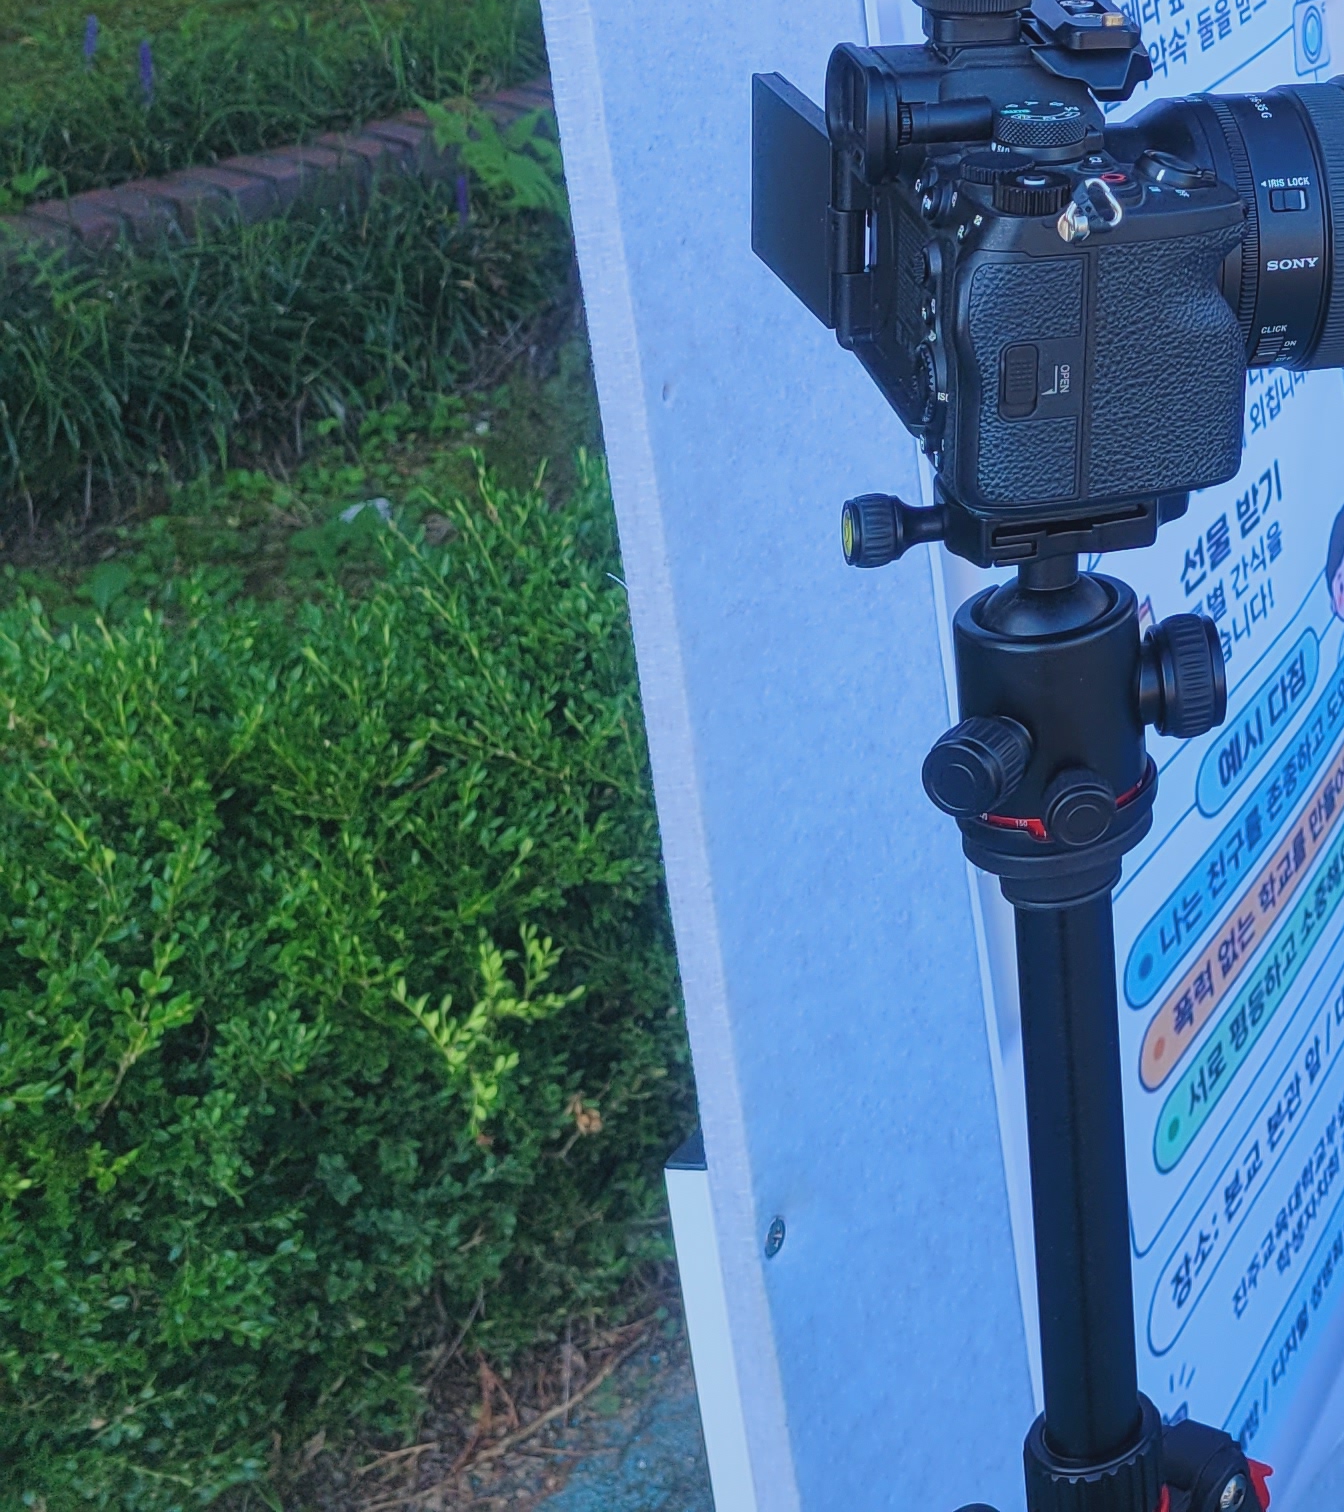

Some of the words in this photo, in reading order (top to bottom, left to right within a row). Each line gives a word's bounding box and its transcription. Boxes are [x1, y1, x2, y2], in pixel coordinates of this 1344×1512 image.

[1268, 178, 1284, 188] IRIS
[1287, 176, 1310, 187] LOCK
[1266, 257, 1319, 271] SONY
[1261, 324, 1287, 334] CLICK
[1060, 364, 1070, 393] OPEN
[1180, 512, 1231, 597] 선물
[1236, 458, 1283, 539] 받기
[1230, 520, 1283, 600] 간식을
[1221, 577, 1275, 665] 습니다!
[1217, 705, 1264, 789] 예시
[1158, 890, 1202, 956] 나는
[1205, 803, 1263, 900] 친구를
[1265, 714, 1325, 821] 존중하고
[1172, 958, 1215, 1036] 폭력
[1218, 912, 1257, 982] 없는
[1258, 828, 1307, 913] 학교를
[1187, 1028, 1228, 1117] 서로
[1228, 931, 1299, 1052] 평등하고
[1169, 1212, 1220, 1310] 장소:
[1223, 1138, 1264, 1224] 본교
[1266, 1070, 1303, 1154] 본관
[1270, 1297, 1311, 1389] 디지털
